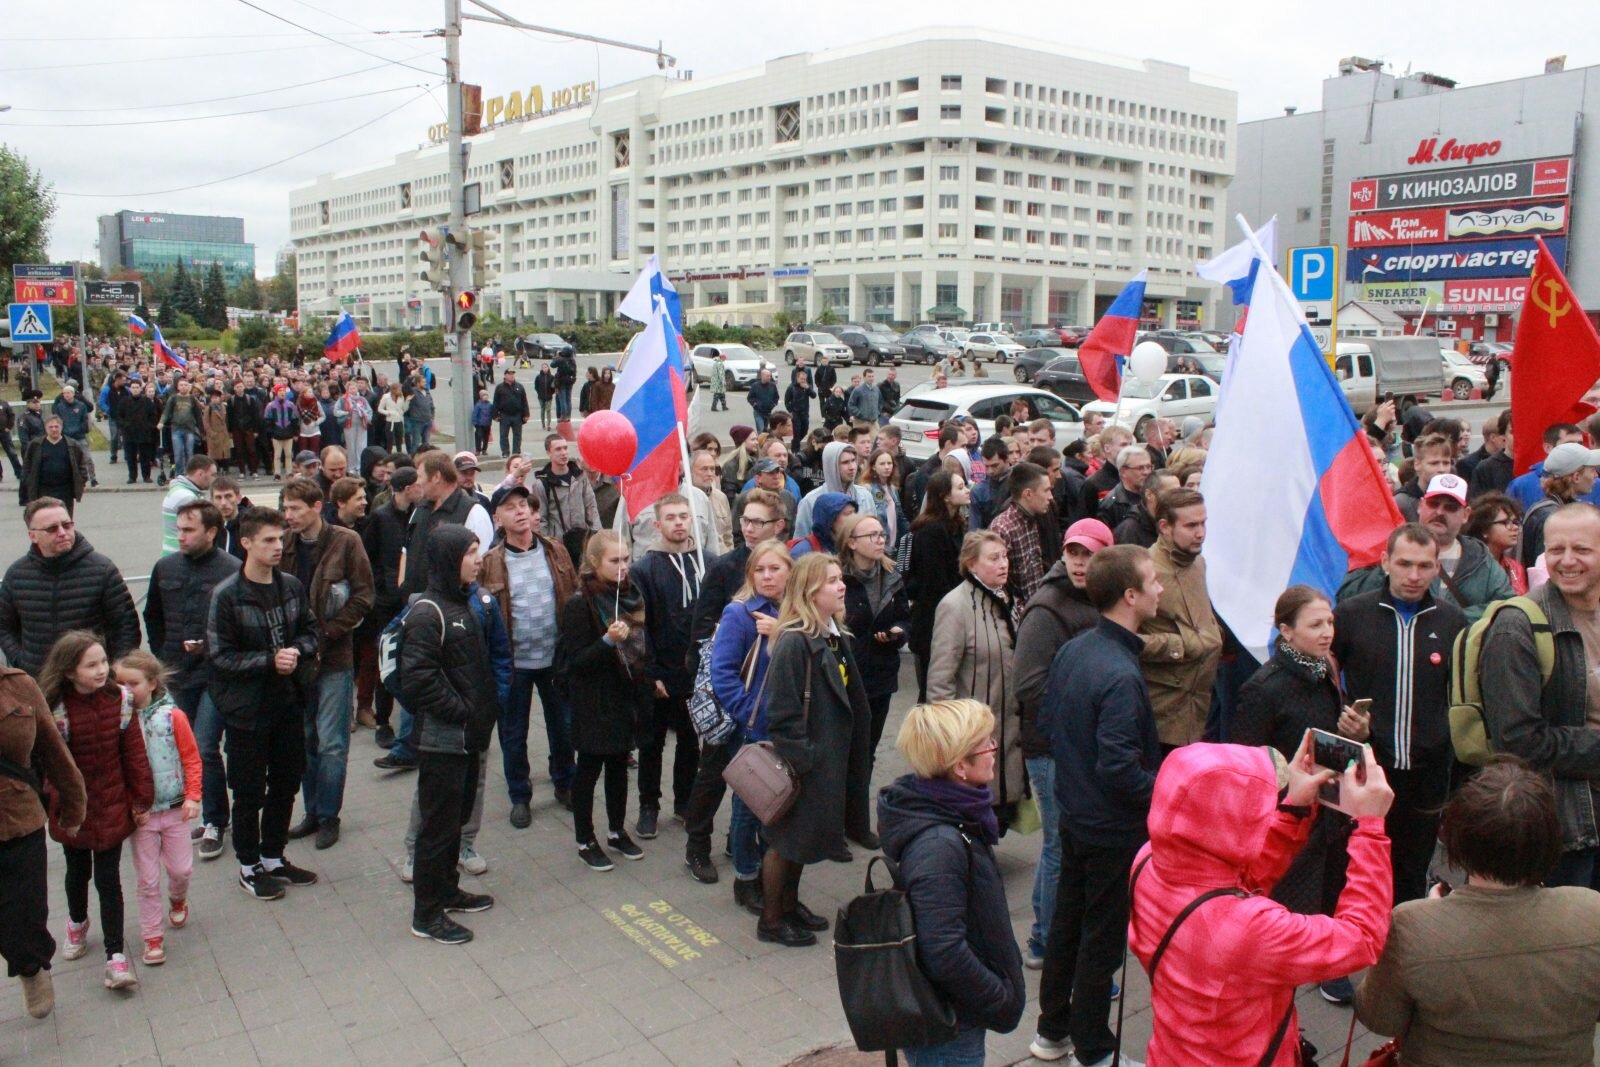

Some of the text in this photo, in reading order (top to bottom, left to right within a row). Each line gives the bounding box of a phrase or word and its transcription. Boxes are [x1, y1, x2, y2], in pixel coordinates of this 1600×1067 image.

[428, 85, 544, 142] ОТЕ РАЛ
[1388, 172, 1517, 200] 9 КИНОЗАЛОВ
[1390, 217, 1420, 230] Дом
[1302, 254, 1325, 294] P
[1368, 287, 1426, 298] SNEAKER
[1448, 287, 1526, 303] SUNLIG
